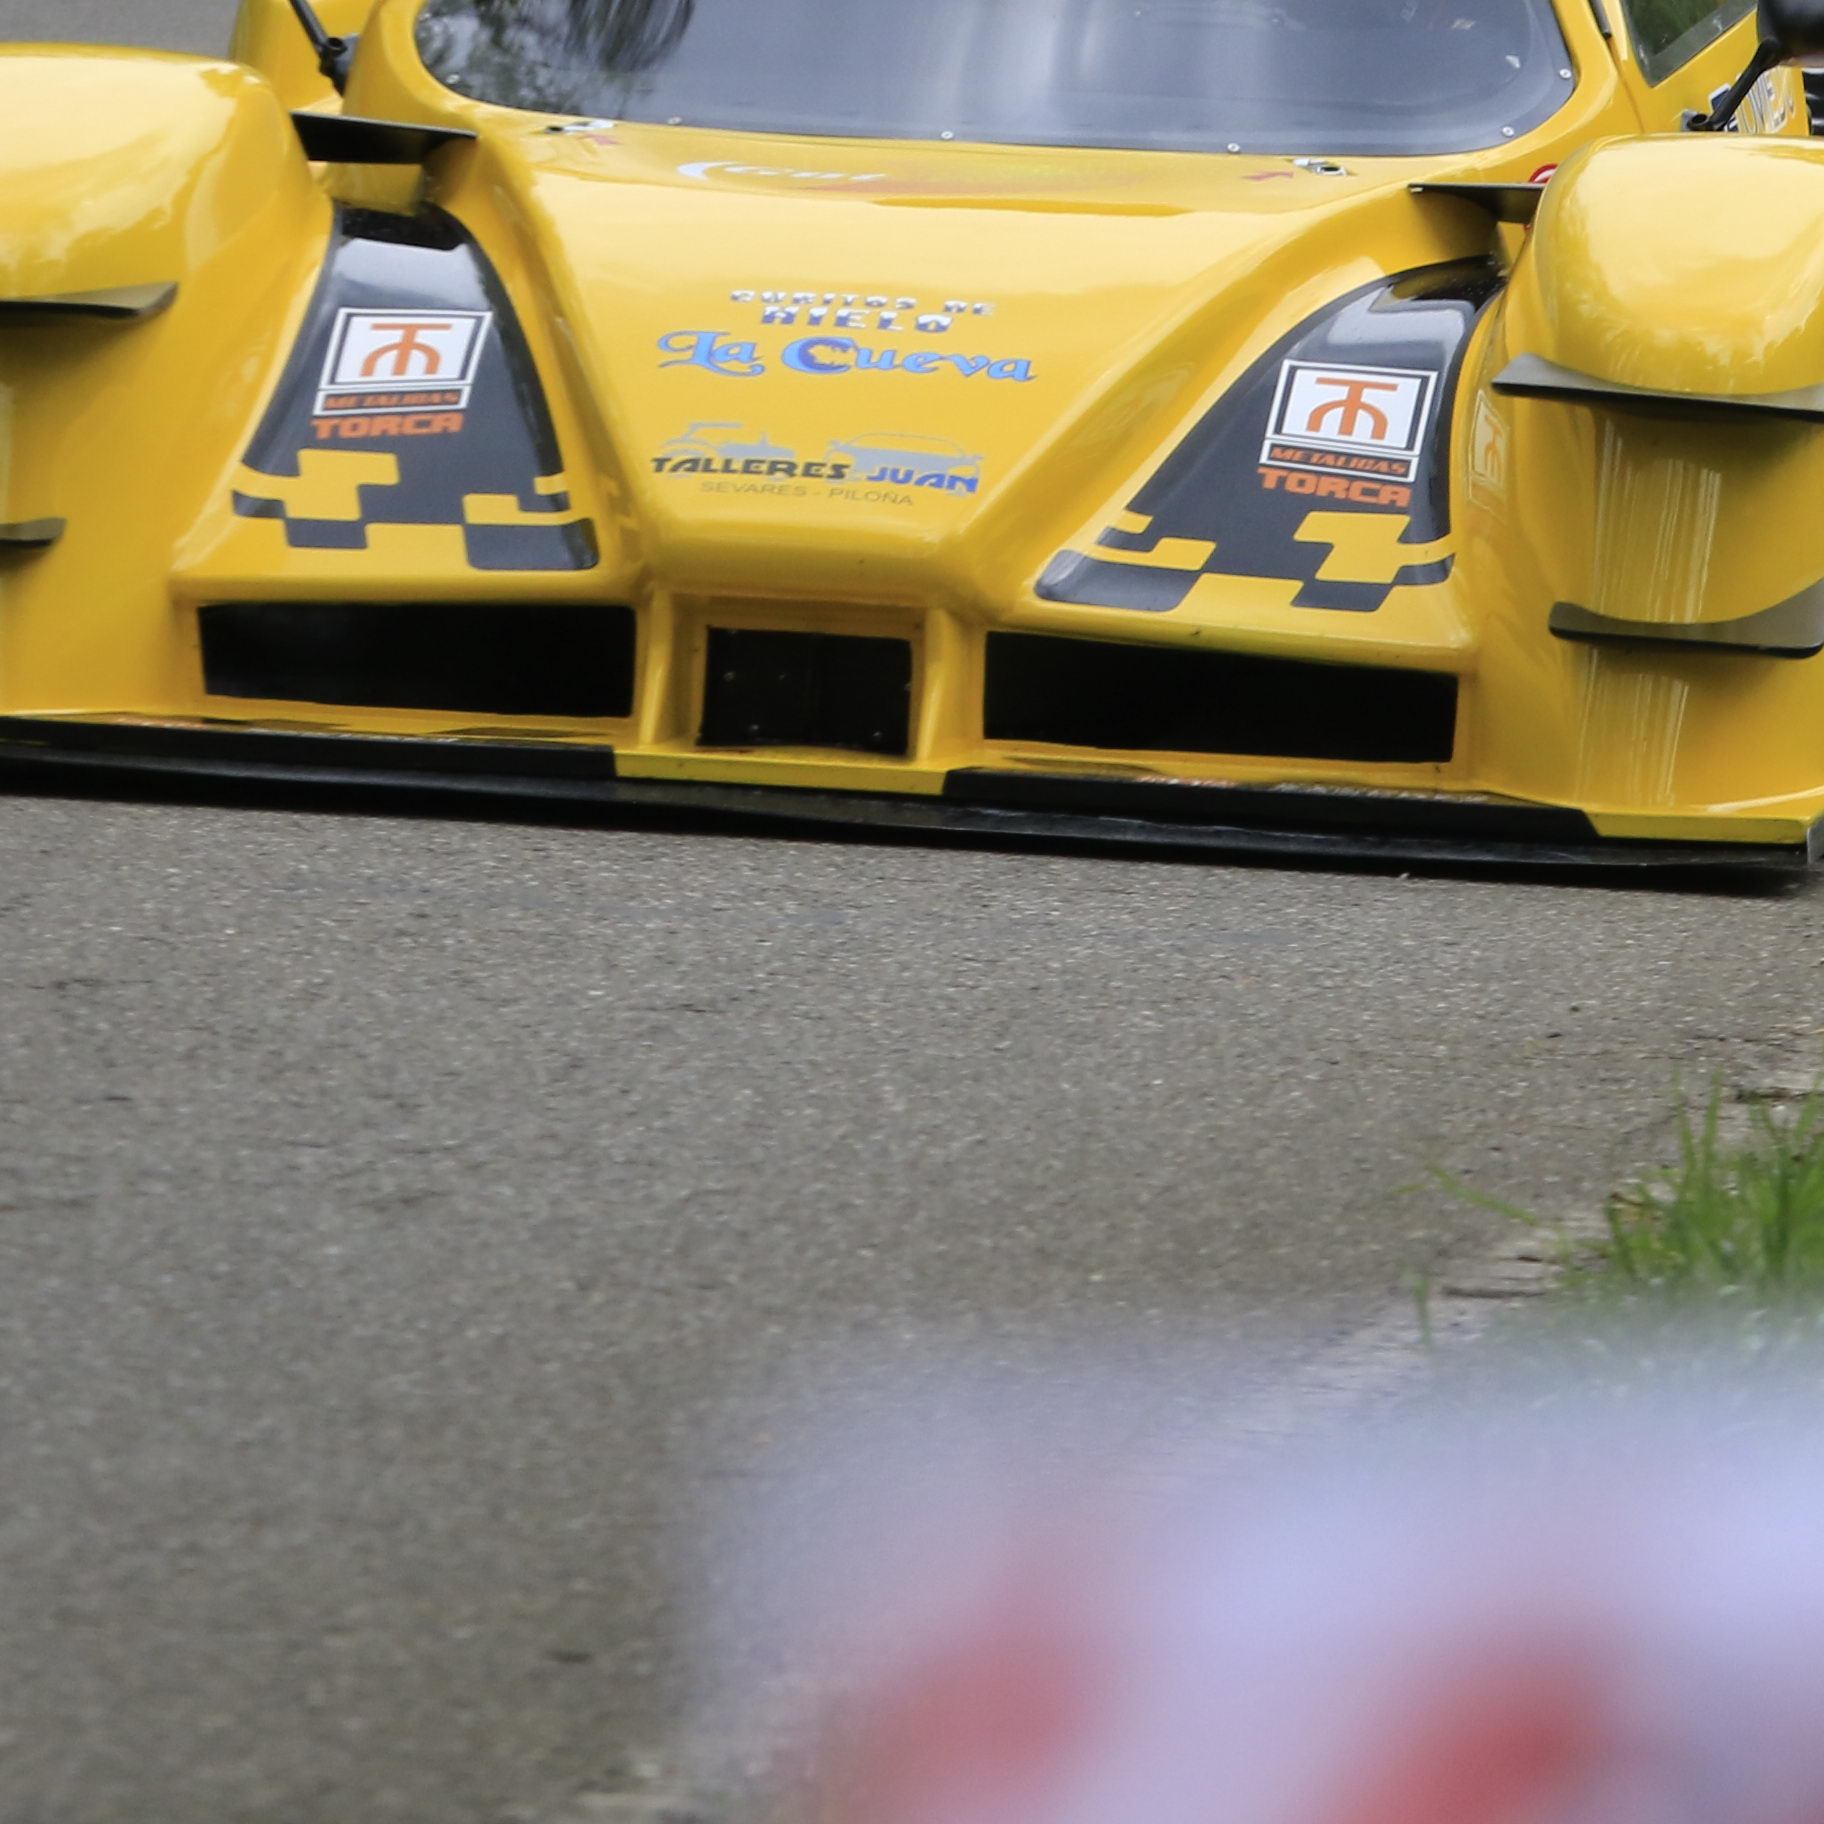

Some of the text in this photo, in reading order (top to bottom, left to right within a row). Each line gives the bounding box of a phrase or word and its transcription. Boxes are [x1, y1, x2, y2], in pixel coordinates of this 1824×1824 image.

[760, 305, 955, 334] HIELO
[780, 335, 1038, 383] Cueva
[310, 411, 465, 440] TORCA
[650, 456, 980, 495] TALLERES JUAN
[1256, 465, 1413, 509] TORCA
[700, 479, 808, 498] SEVARES
[828, 486, 915, 507] PILOÑA
